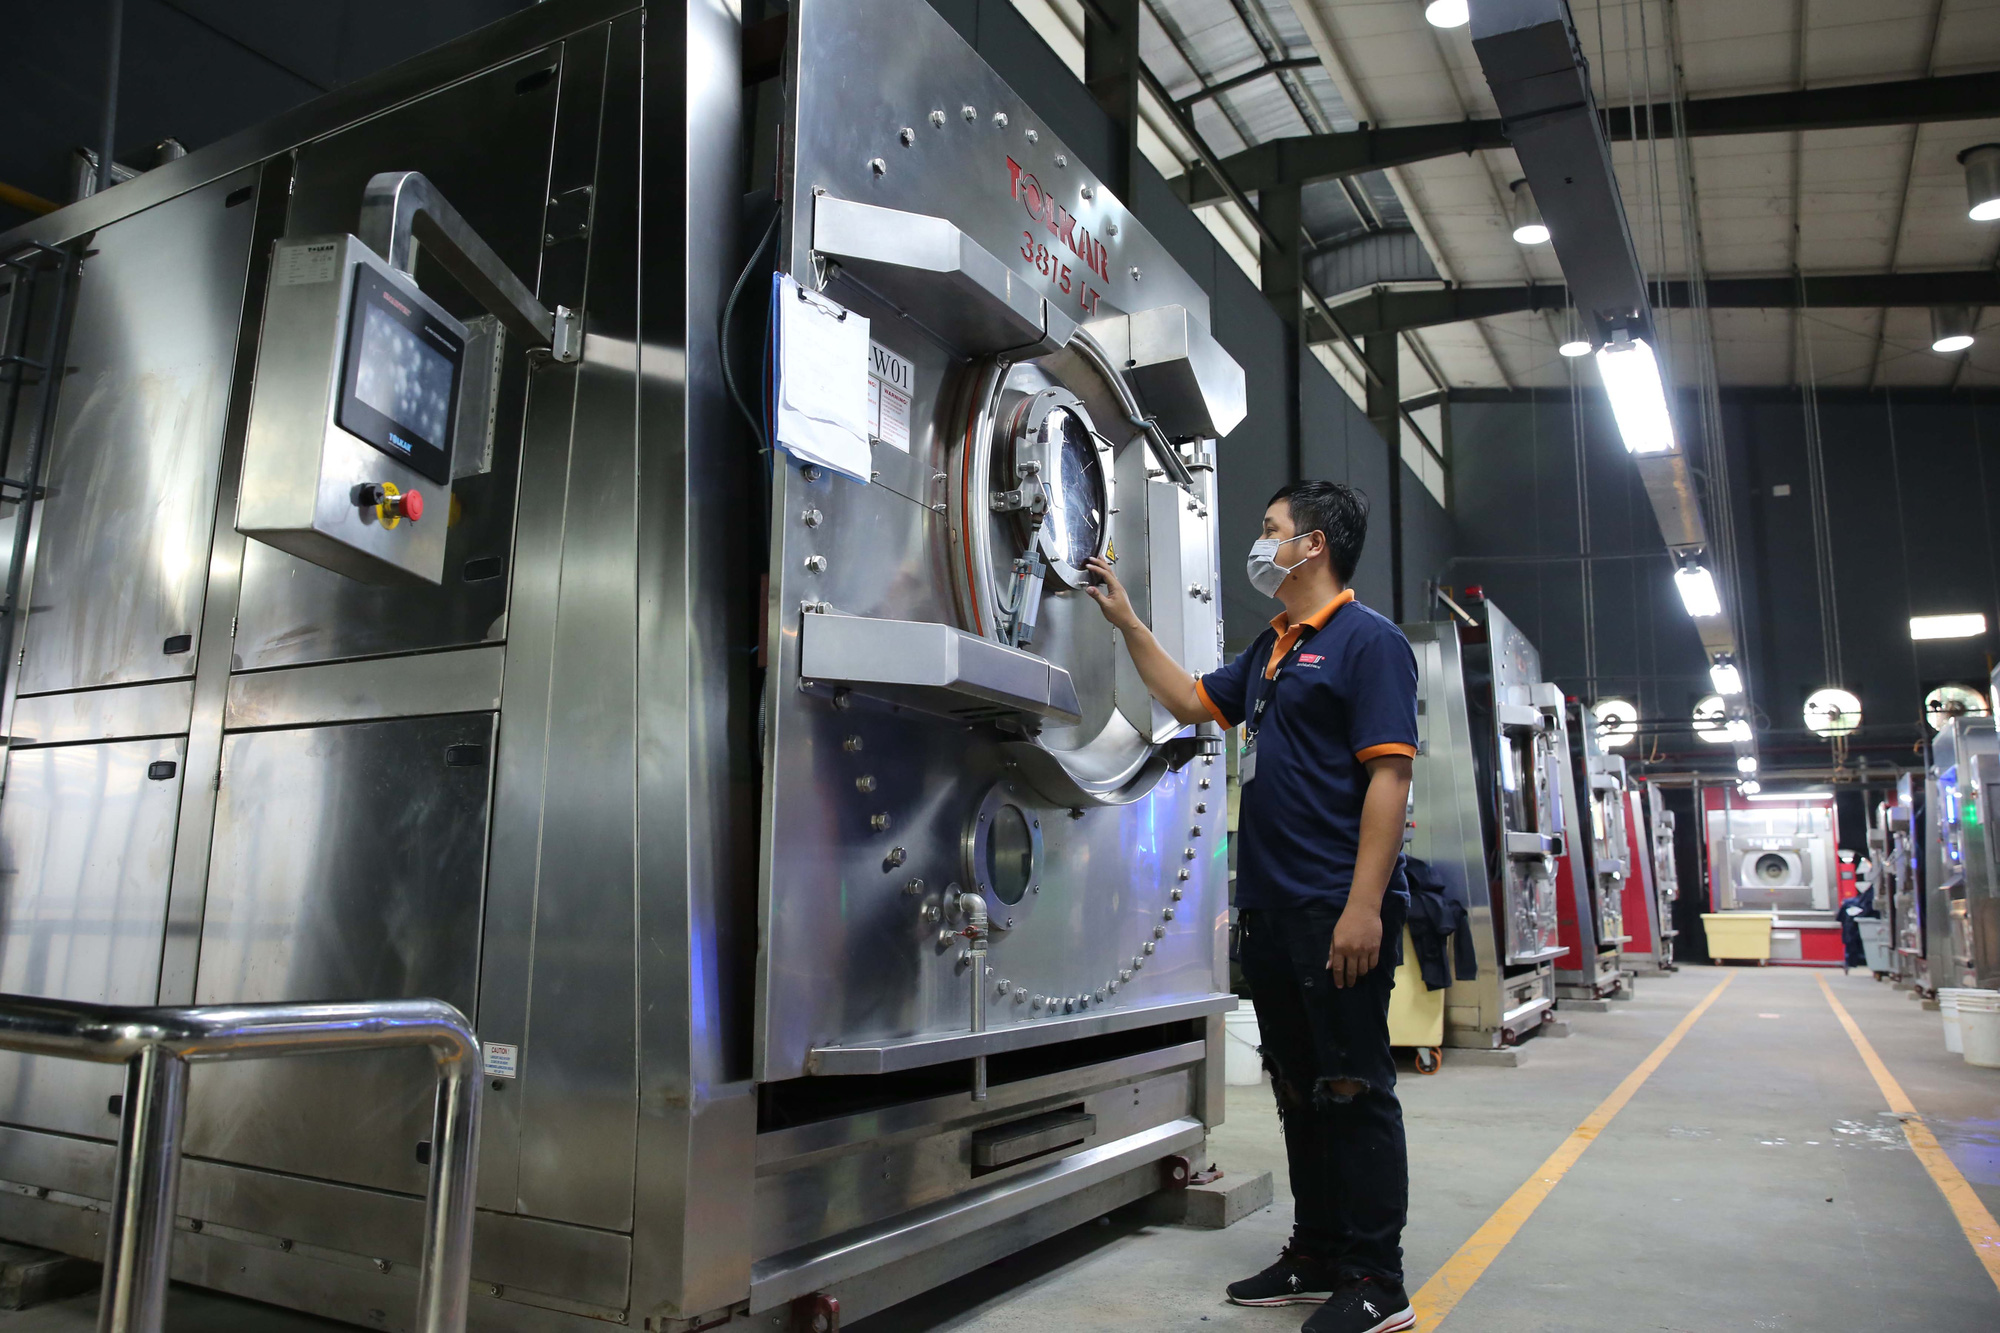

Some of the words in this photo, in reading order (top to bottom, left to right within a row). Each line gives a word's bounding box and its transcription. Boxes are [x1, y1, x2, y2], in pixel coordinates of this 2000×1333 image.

[1006, 154, 1110, 285] TOLKAR
[1020, 230, 1072, 295] 3815
[1080, 280, 1101, 317] LT
